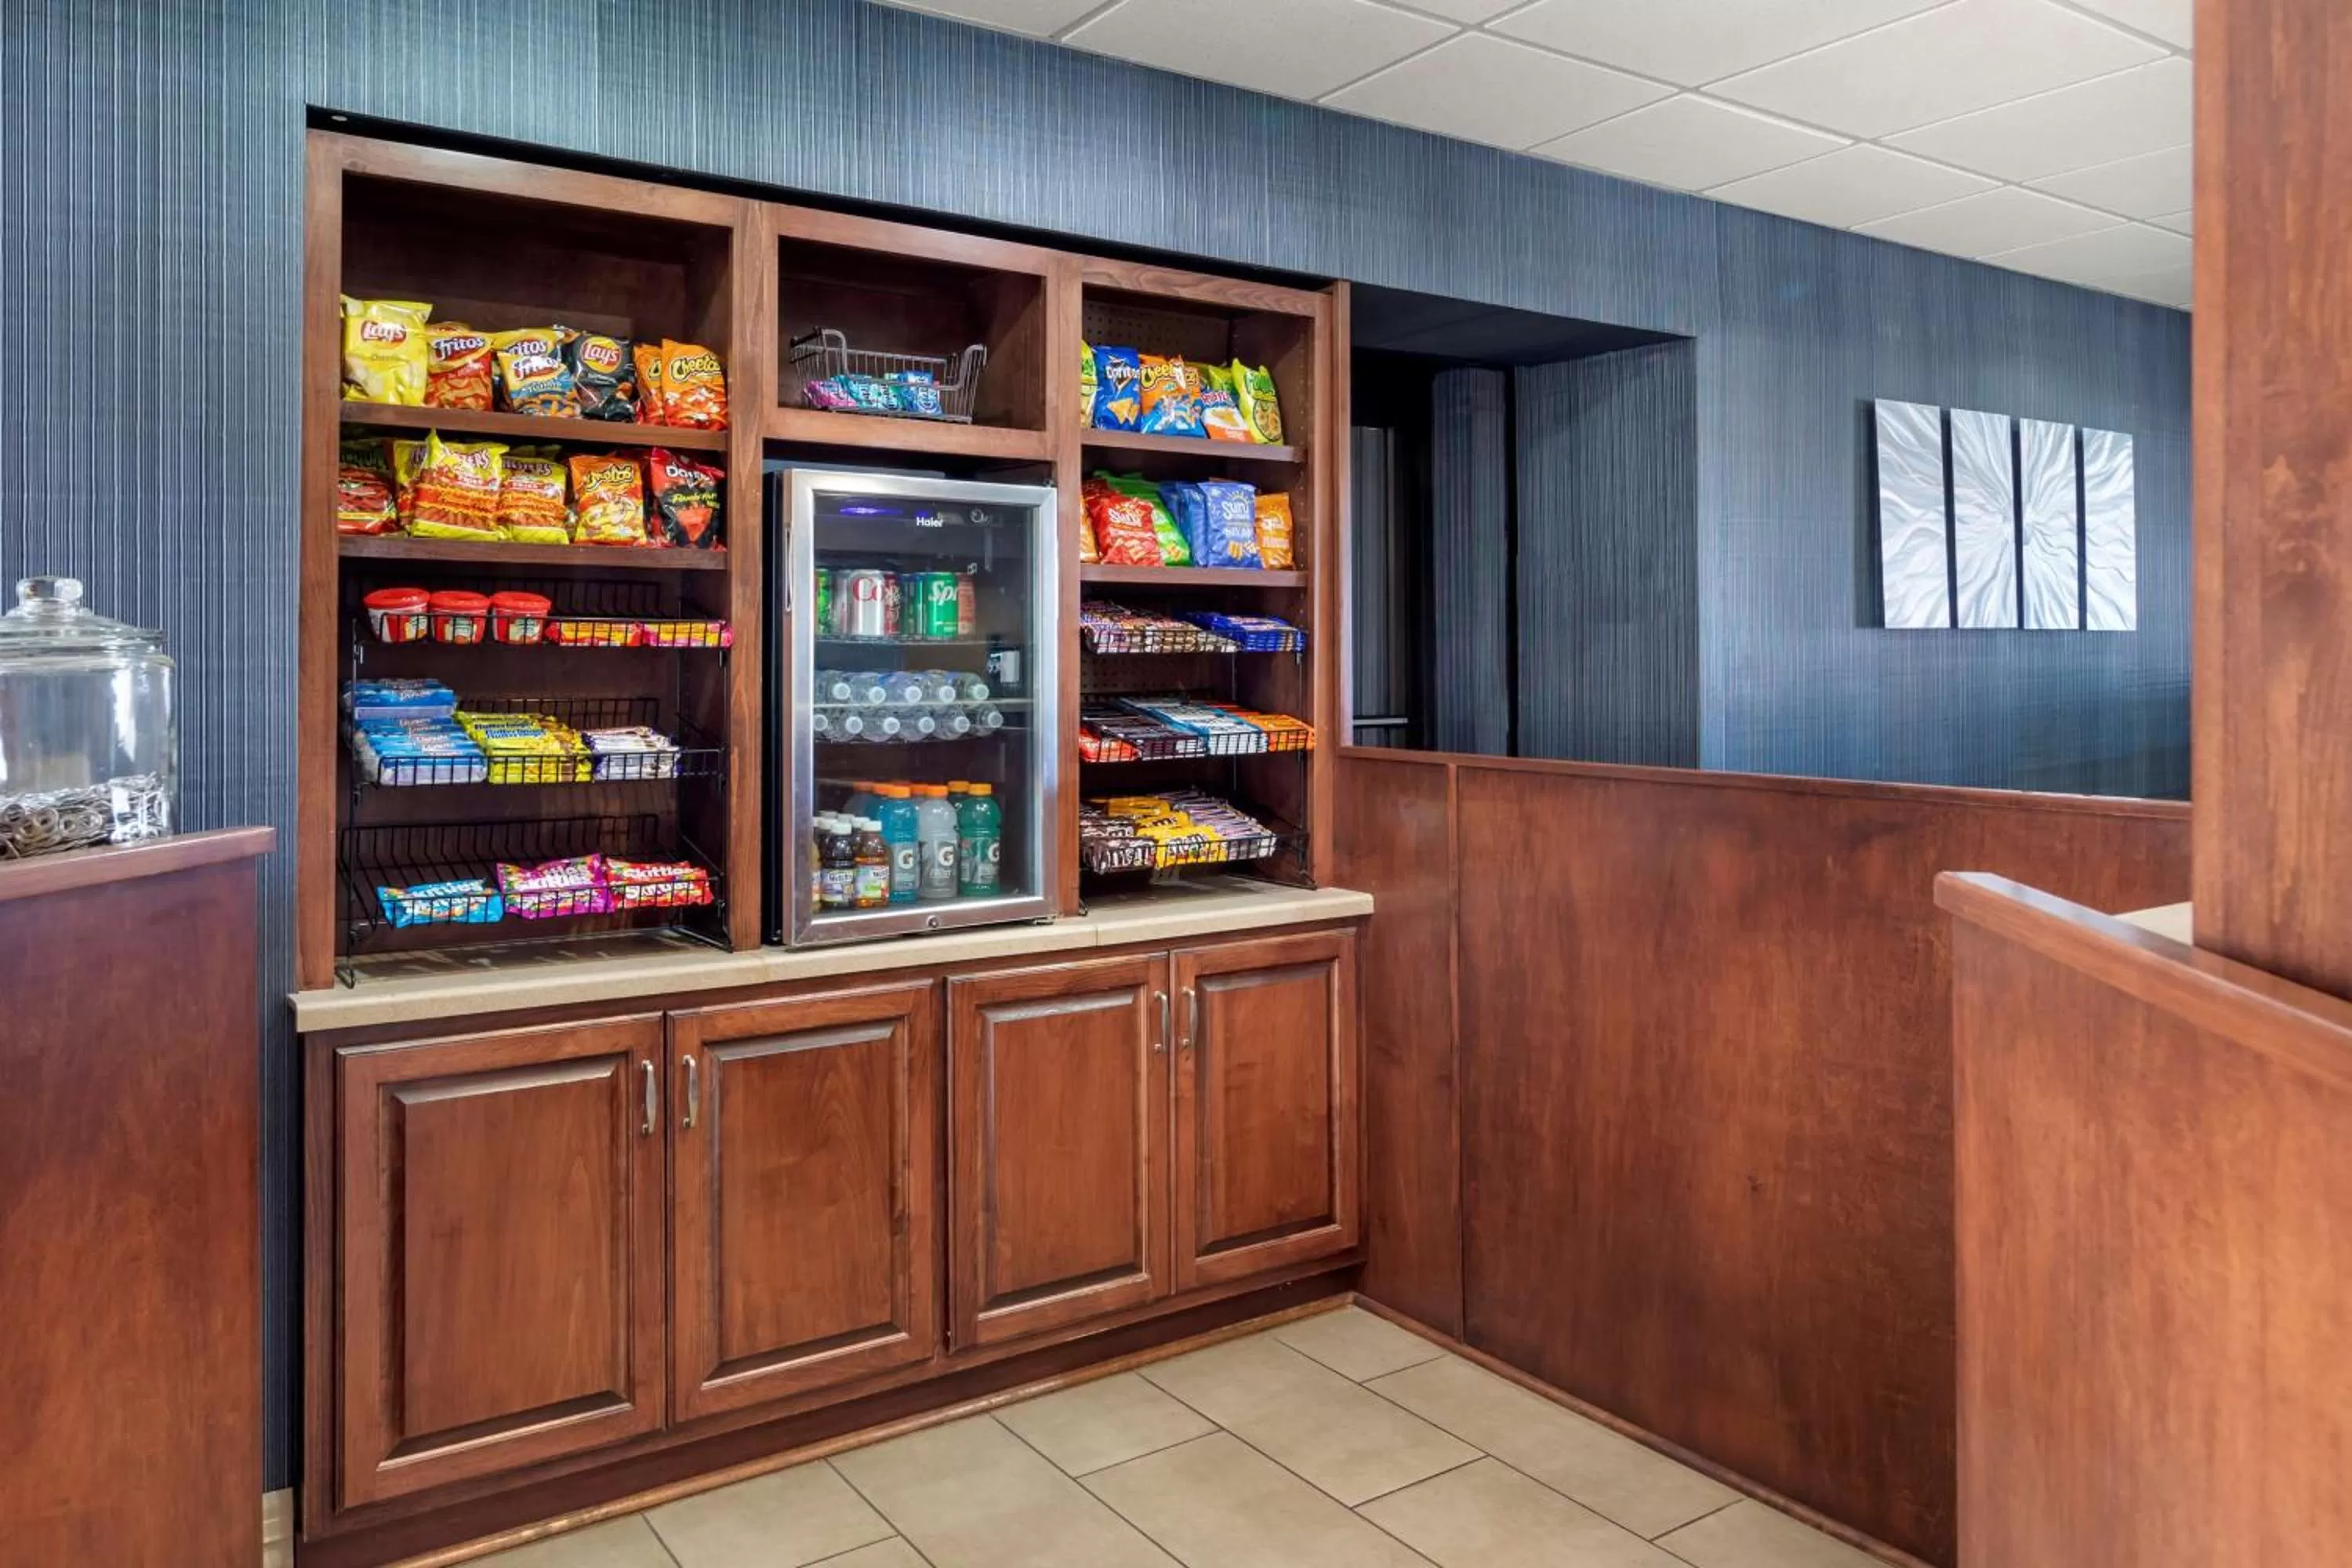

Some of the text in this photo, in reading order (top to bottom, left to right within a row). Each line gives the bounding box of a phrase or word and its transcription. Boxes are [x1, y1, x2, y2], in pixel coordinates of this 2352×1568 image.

[434, 335, 485, 359] Fritos
[507, 339, 546, 355] ritos
[916, 516, 943, 528] Haier
[898, 848, 913, 869] G
[938, 845, 954, 866] G
